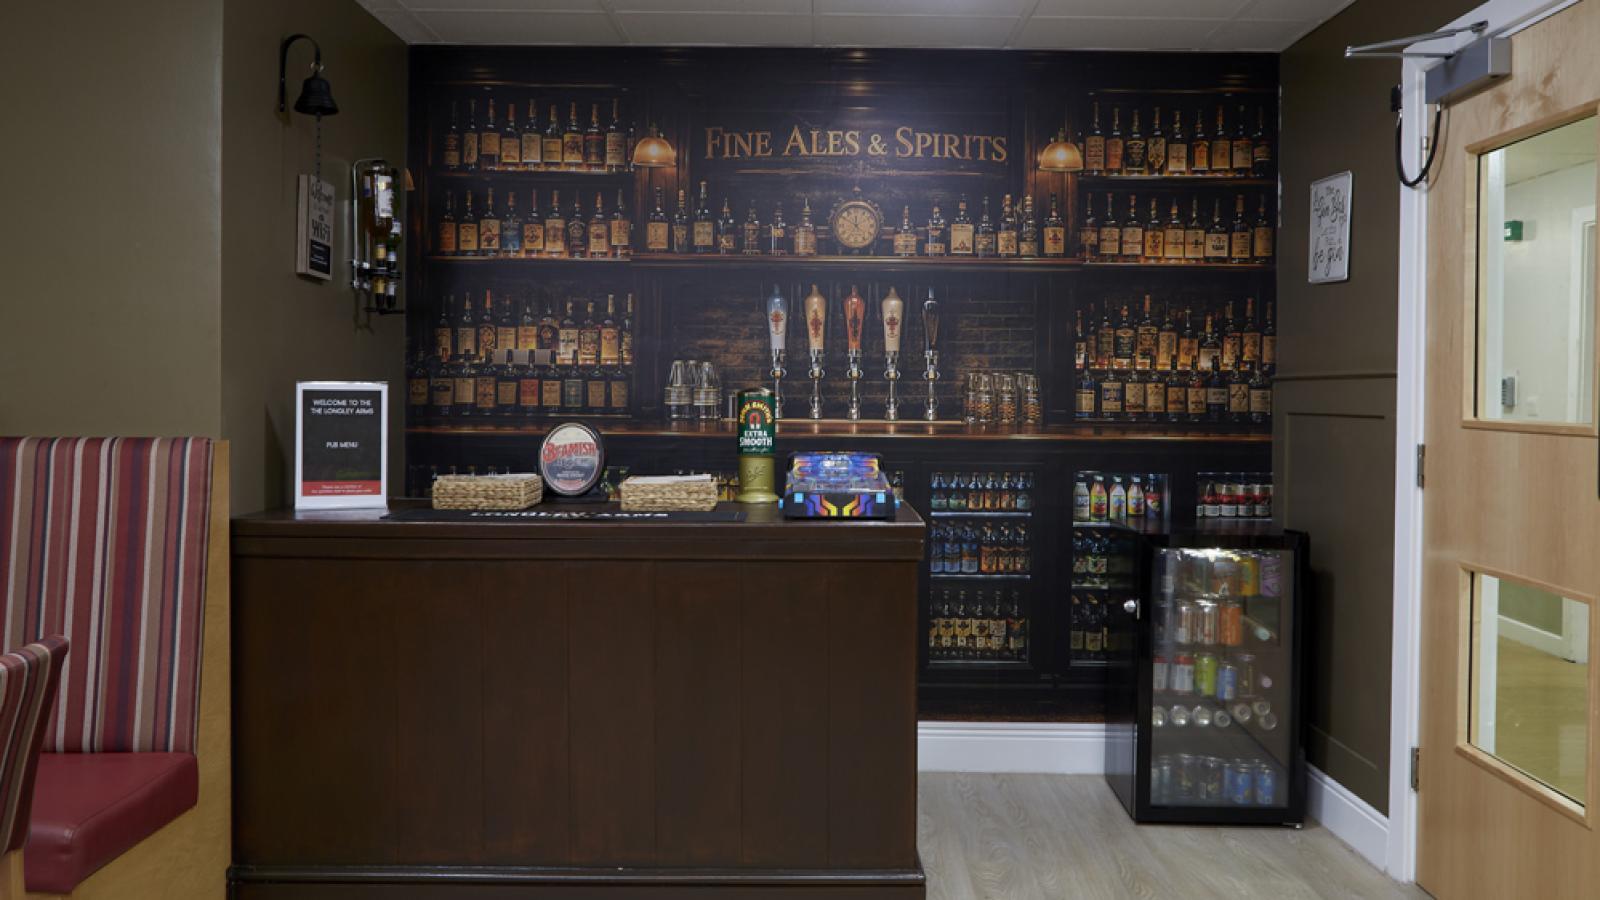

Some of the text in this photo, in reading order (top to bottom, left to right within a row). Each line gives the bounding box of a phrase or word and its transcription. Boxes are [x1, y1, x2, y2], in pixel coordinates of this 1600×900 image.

[704, 124, 1007, 162] FINE ALES & SPIRITS
[355, 407, 374, 415] ARMS
[744, 430, 768, 438] EXTRA
[326, 441, 358, 449] PUB MENU
[739, 437, 773, 448] SMOOTH
[543, 441, 597, 464] BEAMISH
